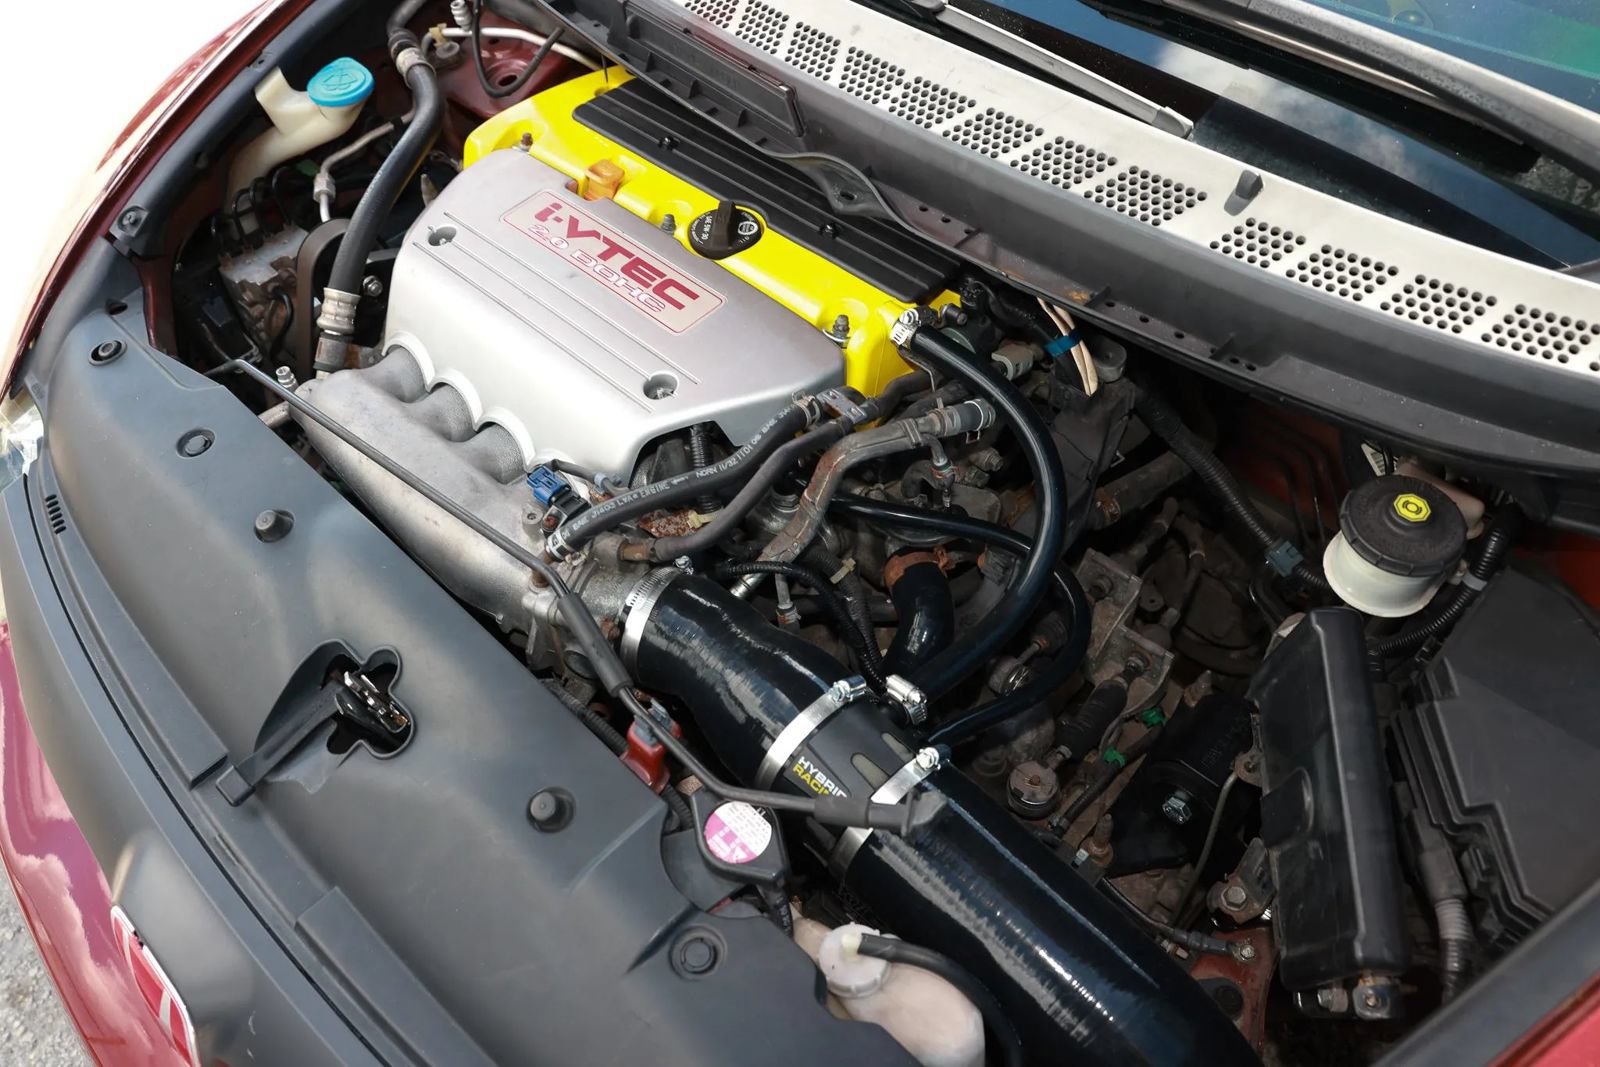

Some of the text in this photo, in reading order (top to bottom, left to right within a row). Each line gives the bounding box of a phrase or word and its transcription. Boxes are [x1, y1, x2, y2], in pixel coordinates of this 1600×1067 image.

[527, 224, 666, 312] 2.0 DOHC
[534, 202, 700, 310] i-VTEC
[640, 484, 670, 499] ENGINE
[792, 763, 830, 795] RACI
